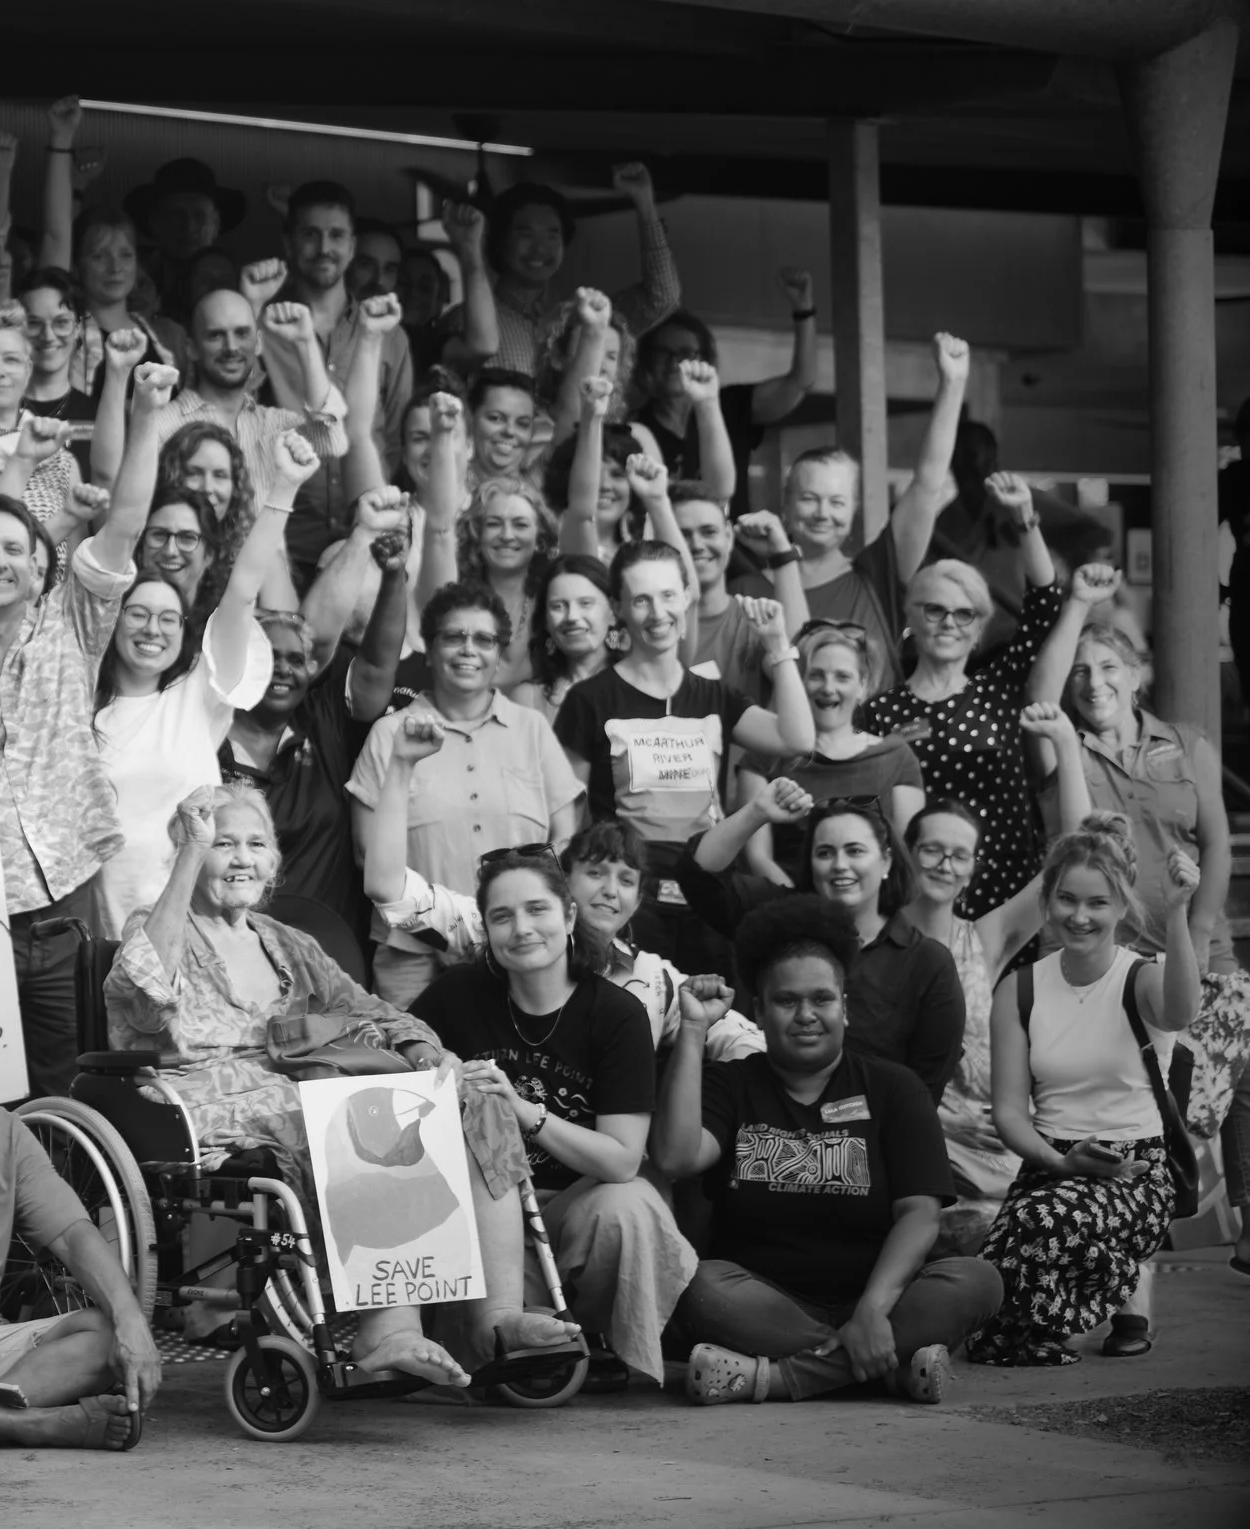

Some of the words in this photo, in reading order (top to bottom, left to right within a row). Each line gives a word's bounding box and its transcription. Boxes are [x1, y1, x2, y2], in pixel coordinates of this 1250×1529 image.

[633, 737, 705, 749] MCARTHUR
[652, 753, 693, 764] RIVER
[525, 1052, 550, 1069] LEE
[554, 1060, 595, 1091] POINT
[741, 1122, 769, 1133] LAND
[768, 1181, 821, 1194] CLIMATE
[822, 1185, 870, 1197] ACTION
[270, 1232, 296, 1249] #54
[372, 1256, 436, 1281] SAVE
[355, 1282, 398, 1306] LEE
[404, 1275, 473, 1302] POINT
